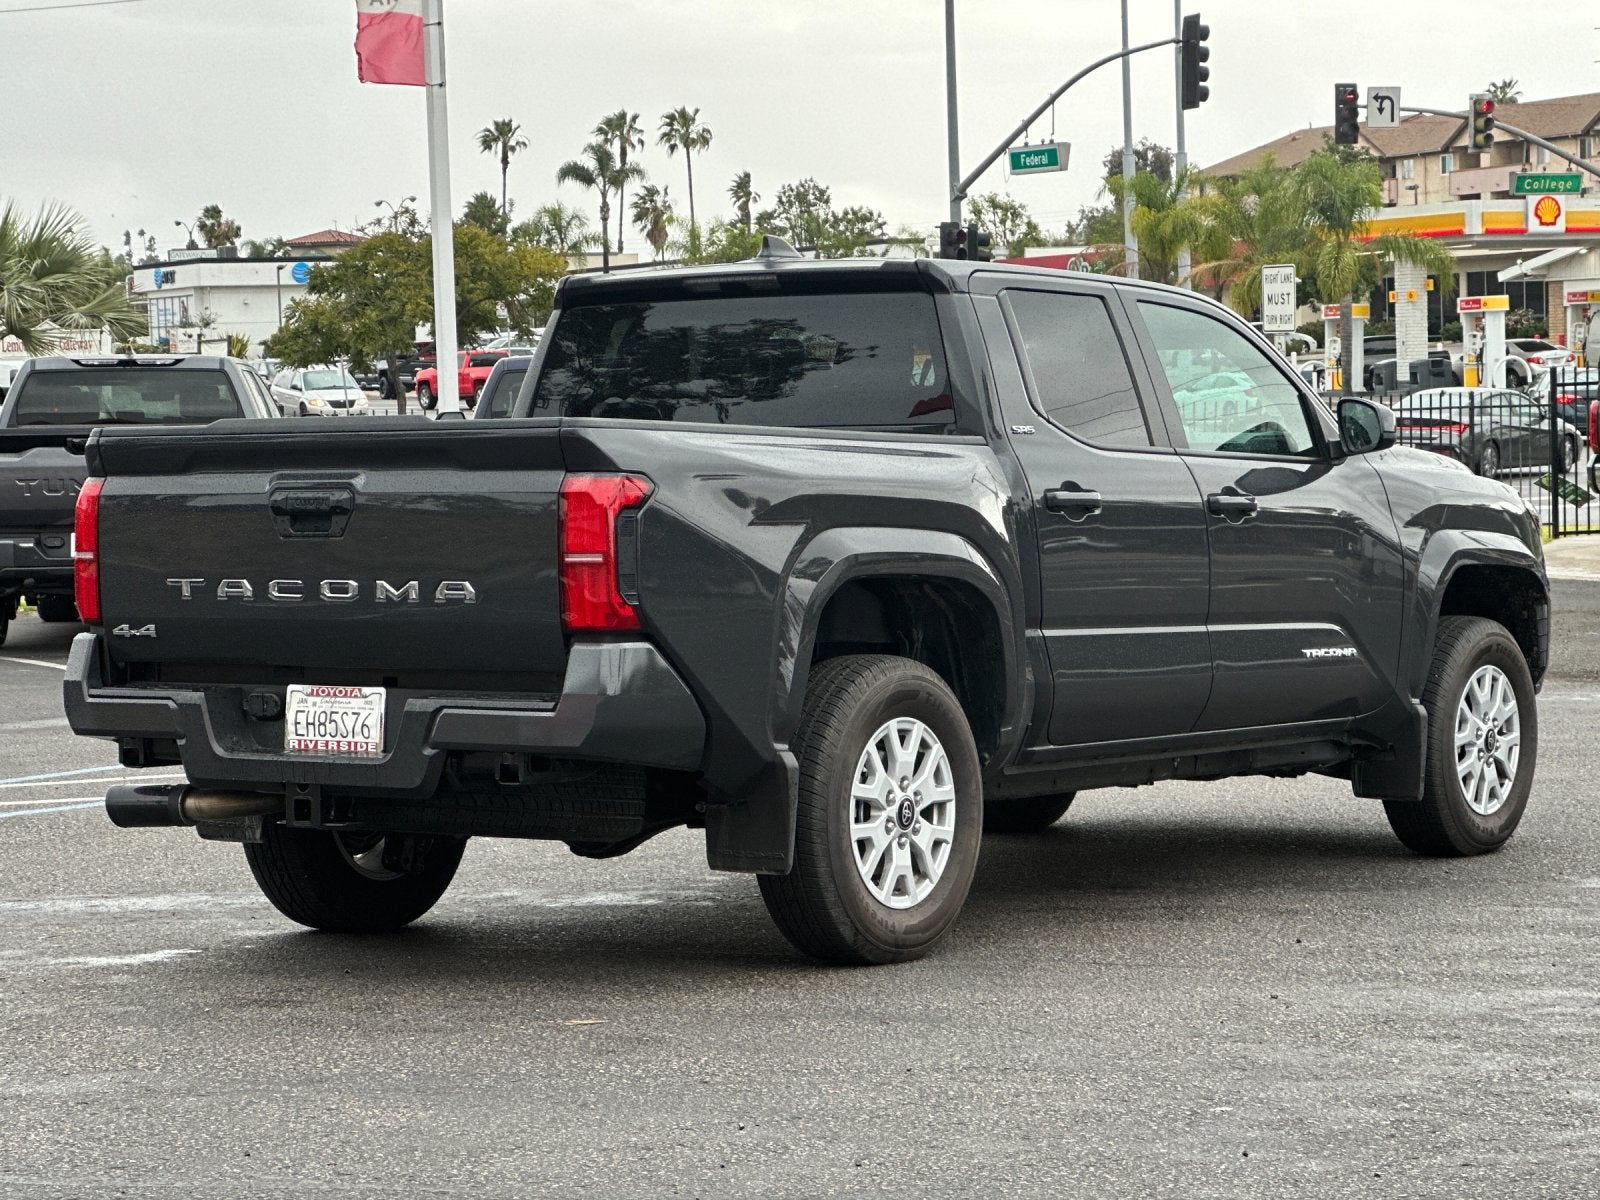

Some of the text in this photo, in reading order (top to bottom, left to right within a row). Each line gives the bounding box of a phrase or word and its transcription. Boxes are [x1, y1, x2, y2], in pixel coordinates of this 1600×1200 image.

[1020, 152, 1048, 166] Federal
[1524, 179, 1573, 192] College
[1265, 273, 1293, 284] RIGHT LANE
[1267, 293, 1291, 305] MUST
[1266, 314, 1293, 324] TURN RIGHT
[1011, 425, 1036, 434] SR5
[15, 478, 82, 496] TUN
[166, 578, 476, 603] TACOMA
[1301, 647, 1358, 658] TACOMA
[312, 687, 361, 697] TOYOTA
[320, 697, 352, 708] California
[294, 709, 373, 740] EH85S76
[289, 739, 377, 752] RIVERSIDE
